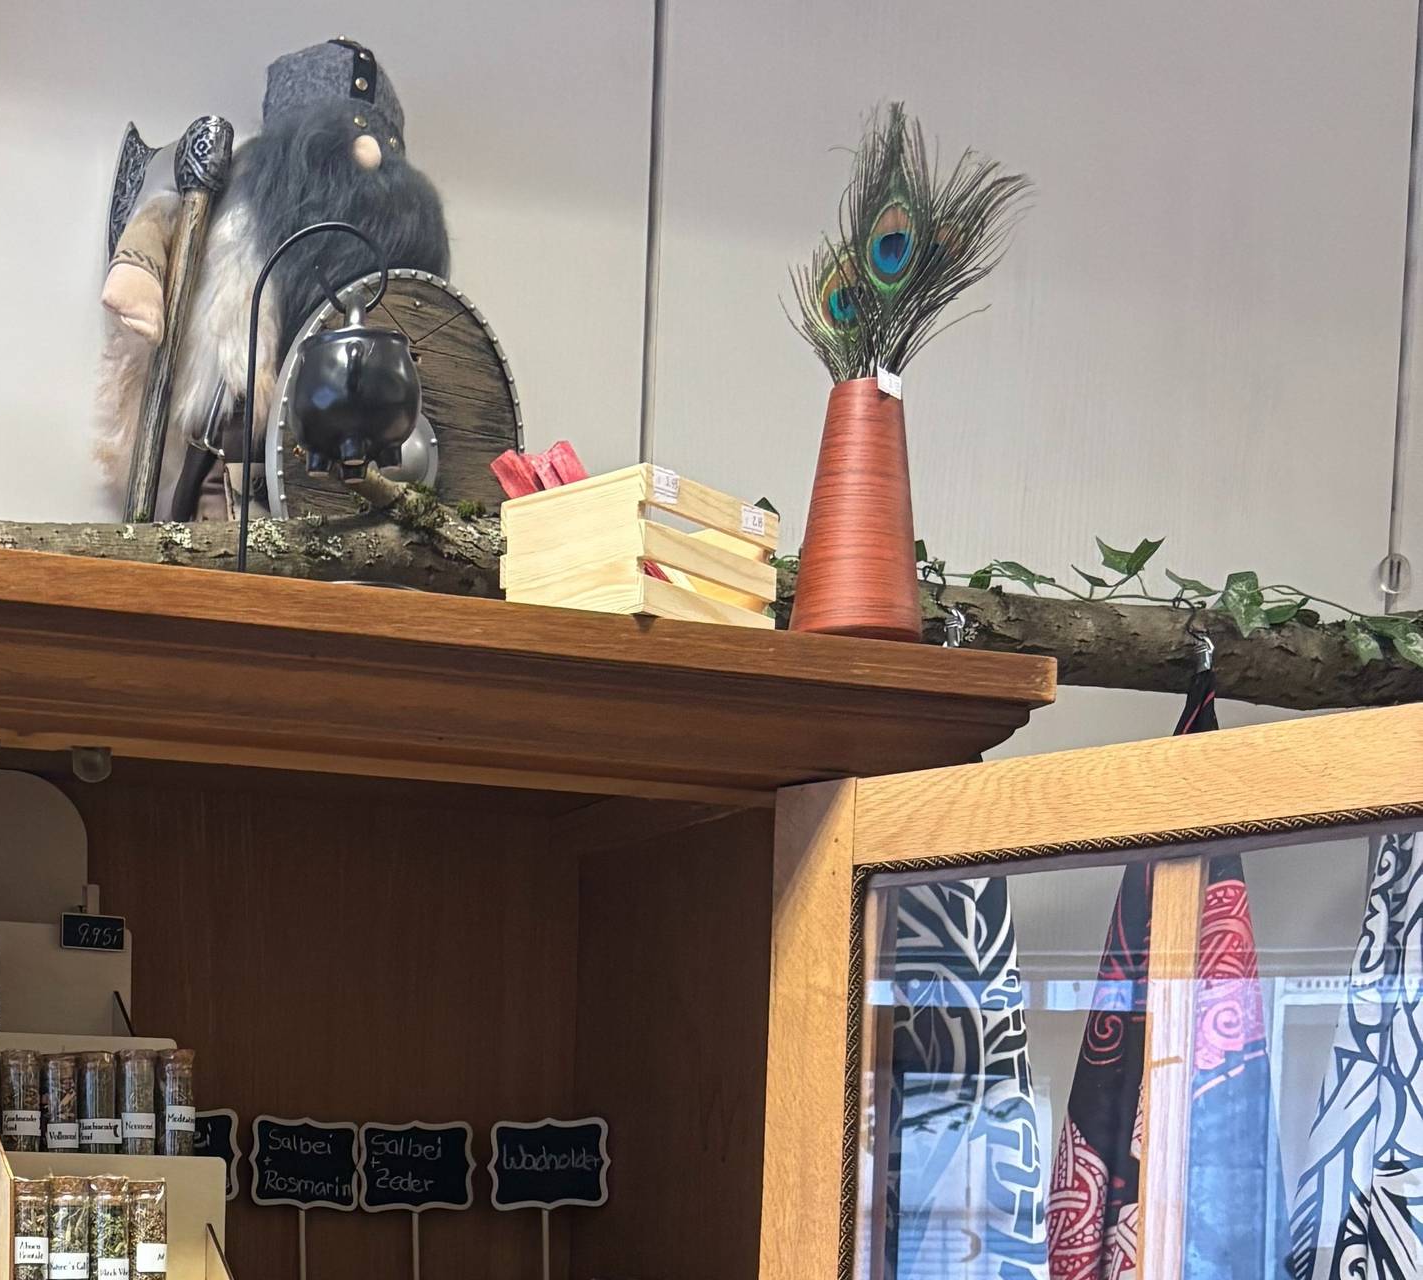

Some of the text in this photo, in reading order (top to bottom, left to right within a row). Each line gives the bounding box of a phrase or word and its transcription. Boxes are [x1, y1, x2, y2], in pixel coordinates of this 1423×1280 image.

[268, 1128, 334, 1155] Salbei
[371, 1134, 442, 1161] Salbei
[264, 1169, 352, 1198] Rosmarin
[376, 1167, 435, 1194] Zeder
